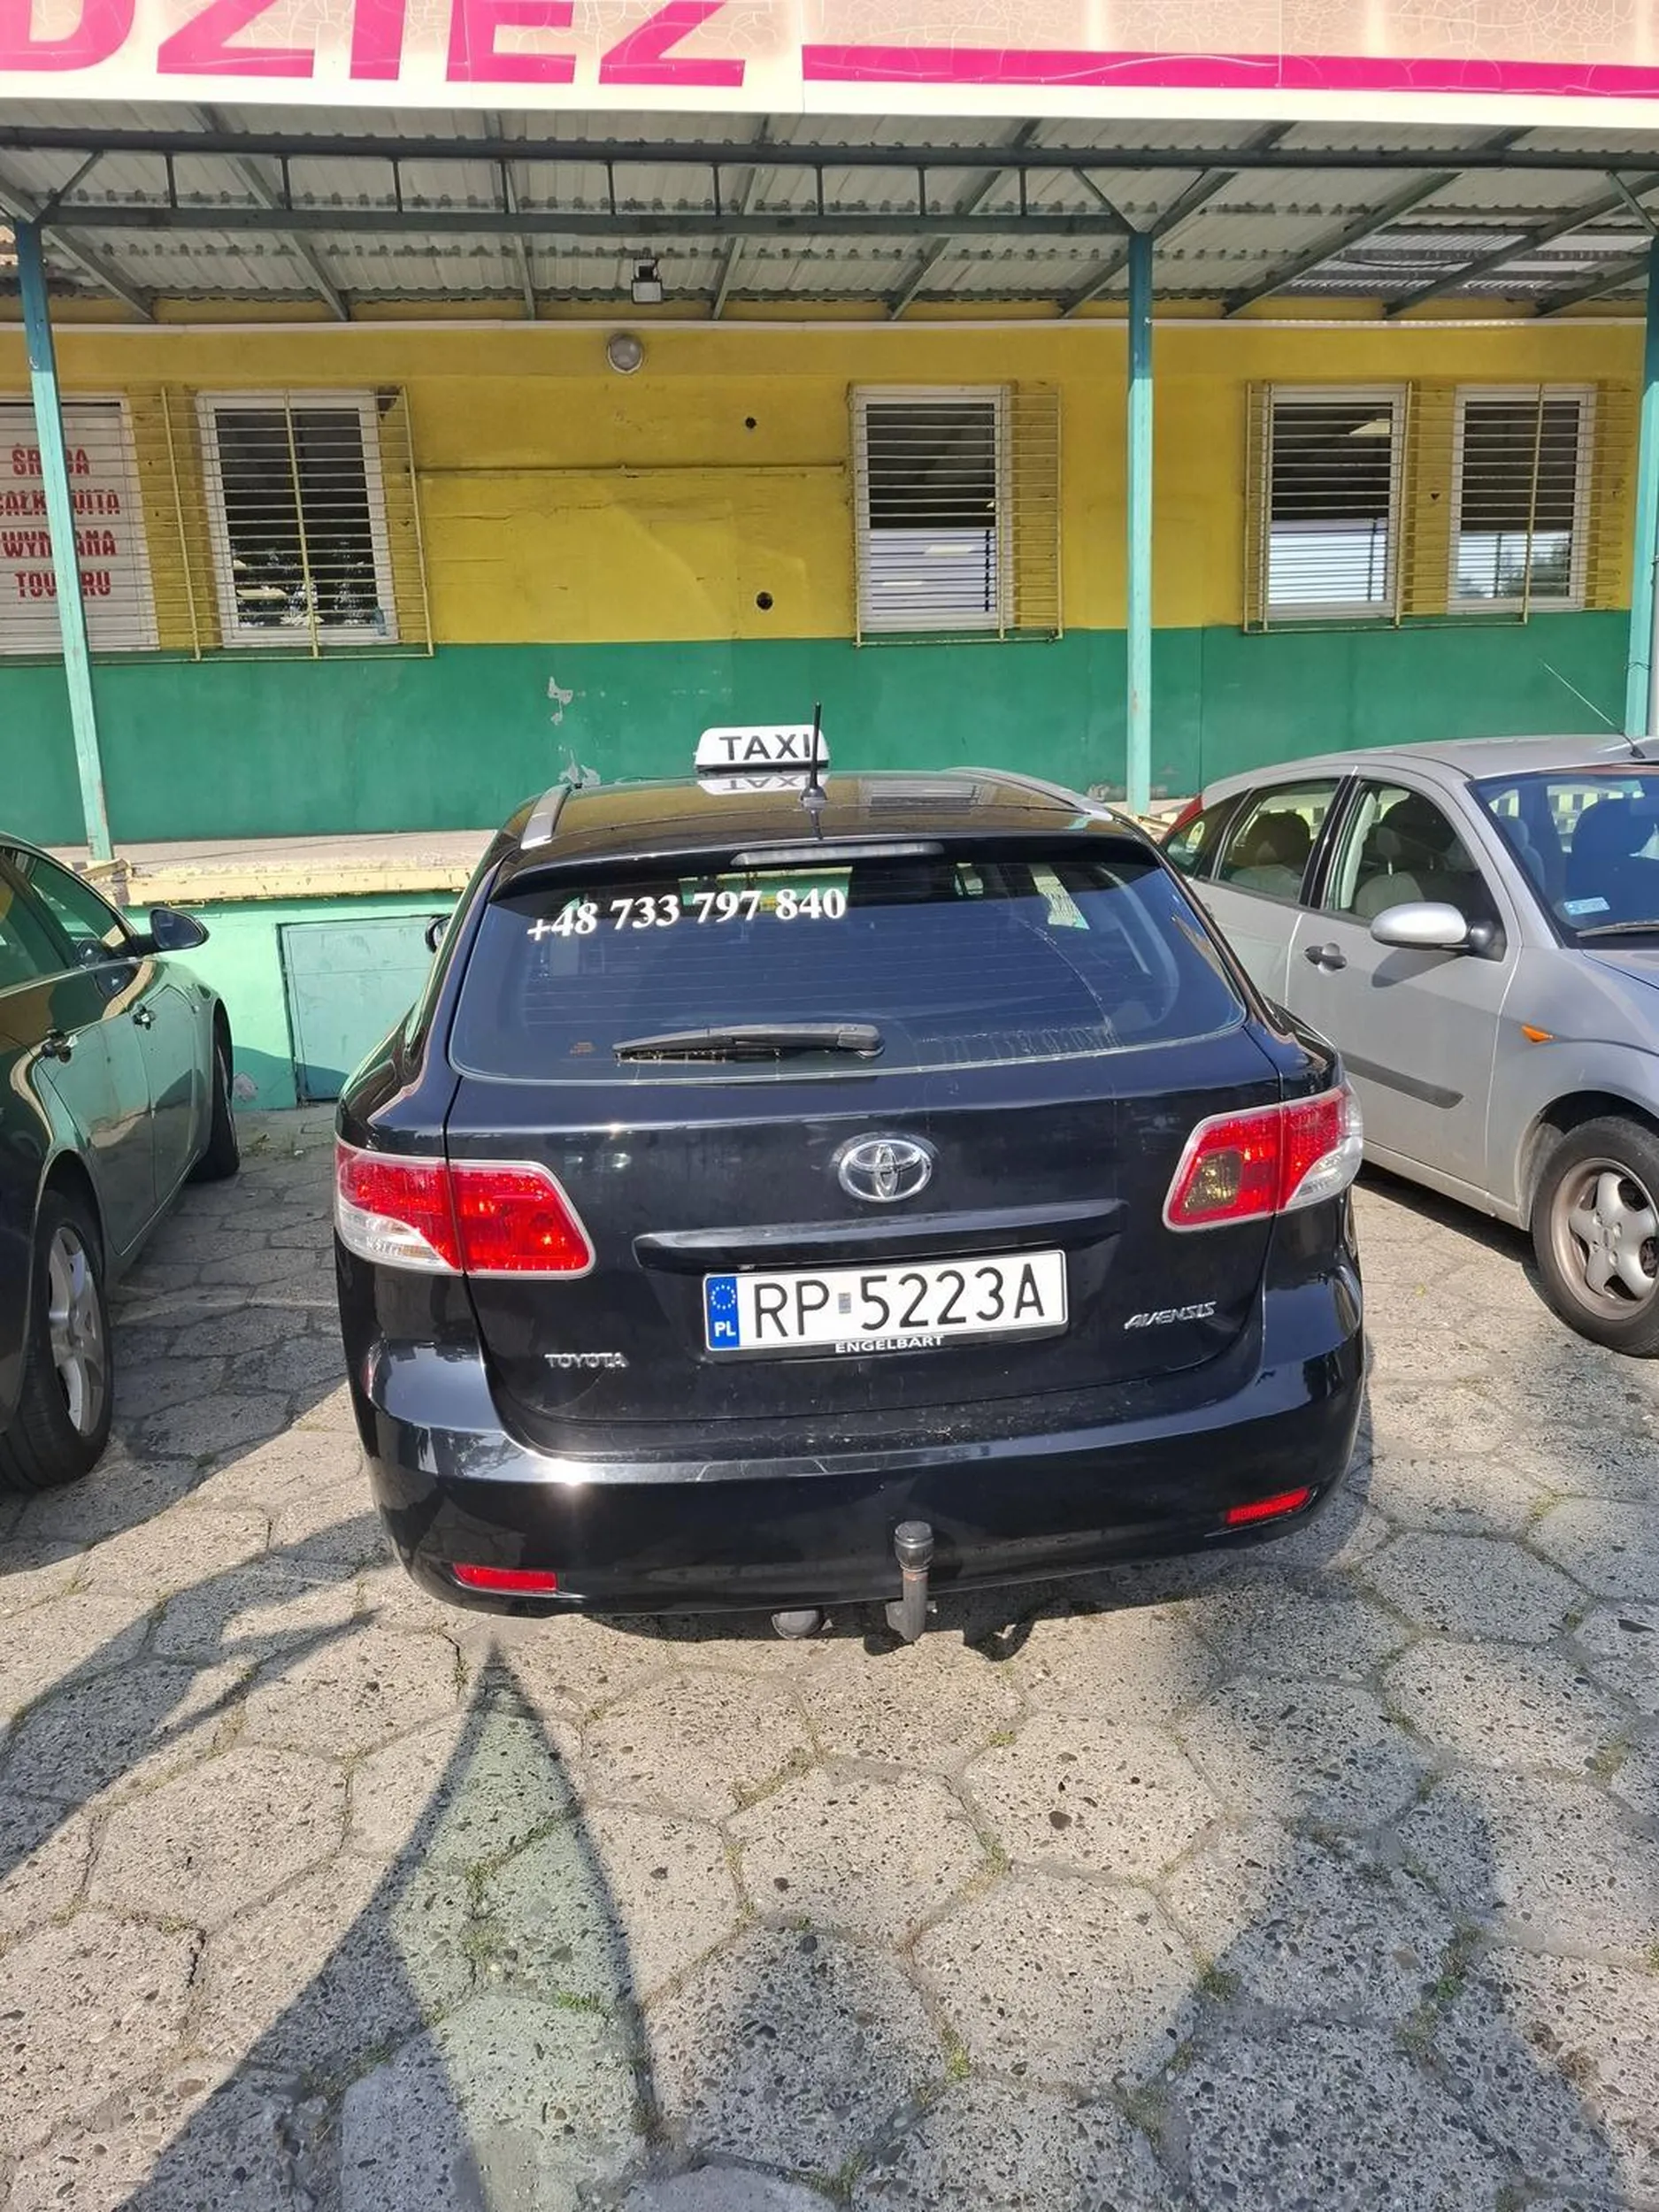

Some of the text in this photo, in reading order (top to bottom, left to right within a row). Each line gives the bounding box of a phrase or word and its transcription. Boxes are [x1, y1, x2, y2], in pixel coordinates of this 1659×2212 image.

[12, 442, 90, 475] ŚRA
[0, 488, 120, 516] AŁKWITA
[2, 529, 116, 557] WYMANA
[15, 571, 111, 598] TOWRU
[718, 733, 810, 762] TAXI
[526, 887, 847, 941] +48 733 797 840
[754, 1263, 1045, 1339] RP 5223A
[1124, 1301, 1217, 1329] AVENSIS
[714, 1322, 736, 1337] PL
[834, 1334, 945, 1354] ENGELBART
[544, 1352, 630, 1369] TOYOTA
